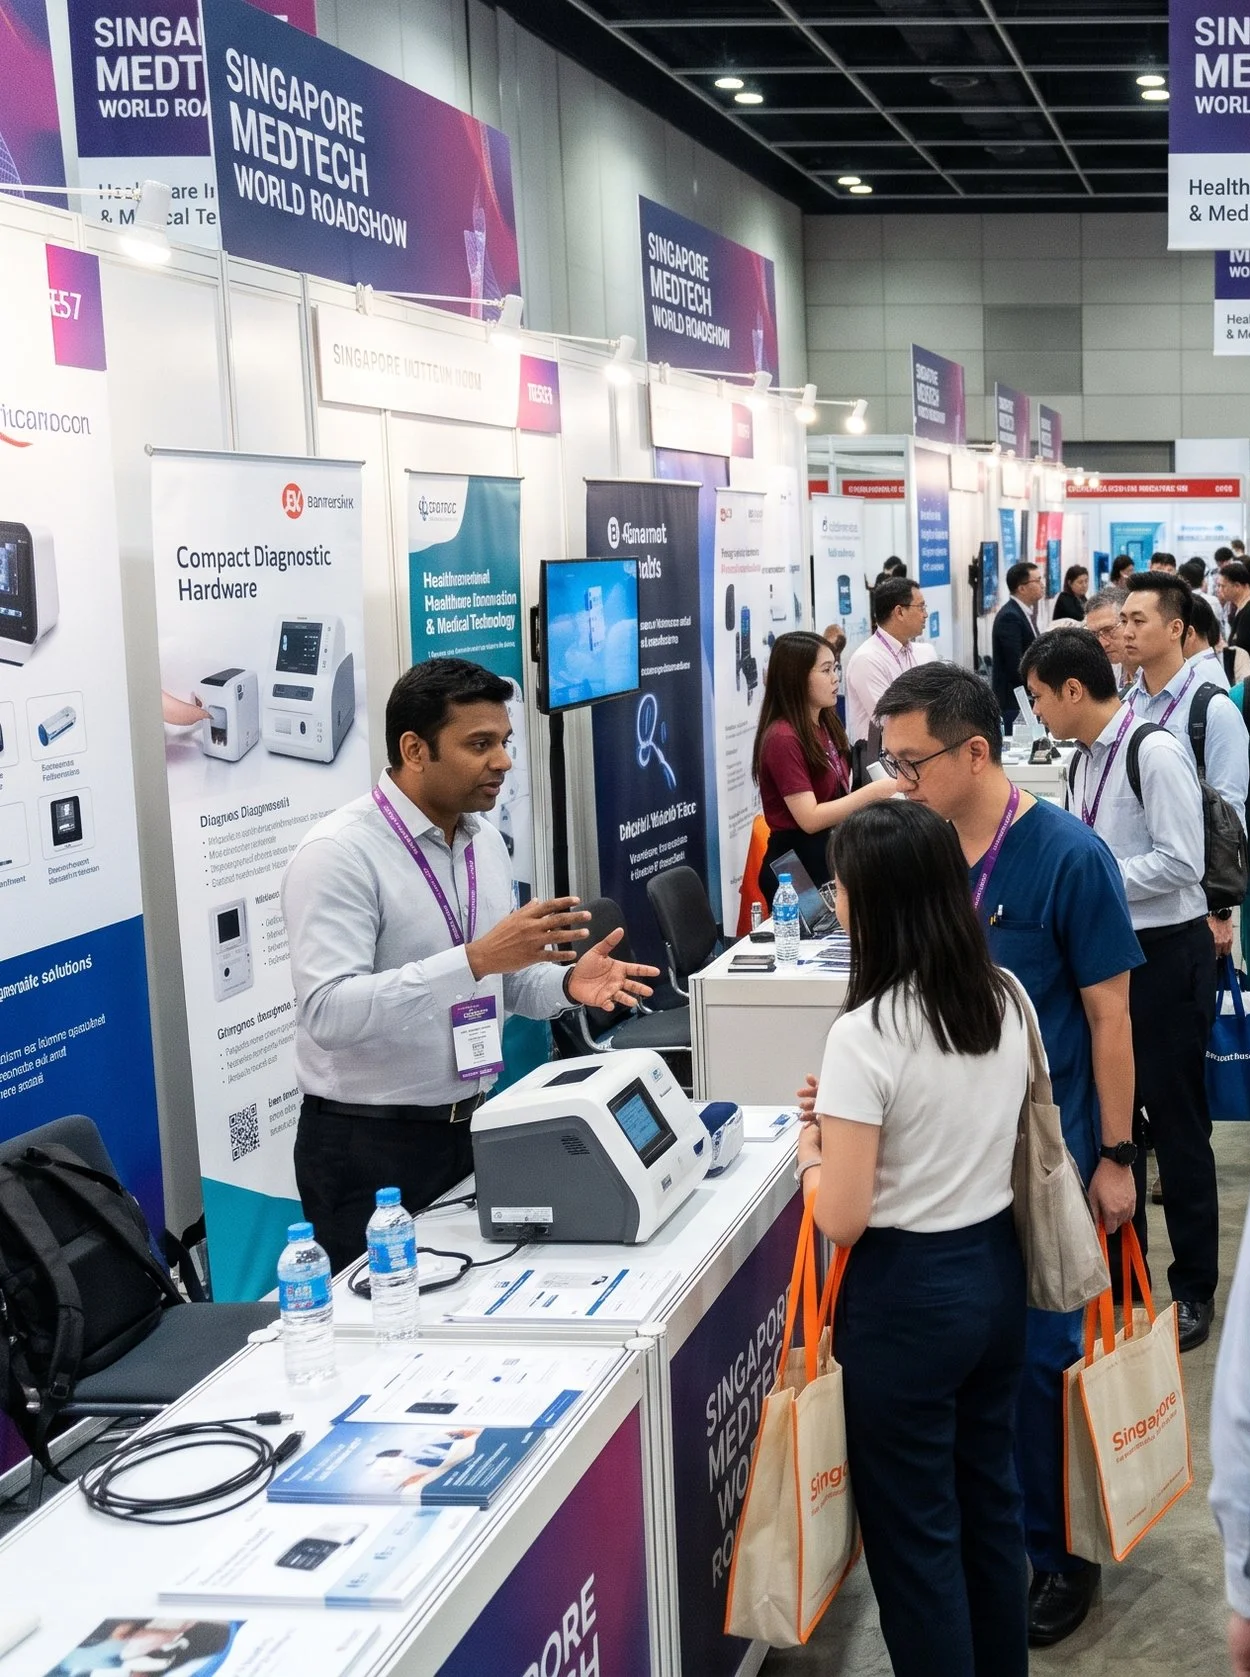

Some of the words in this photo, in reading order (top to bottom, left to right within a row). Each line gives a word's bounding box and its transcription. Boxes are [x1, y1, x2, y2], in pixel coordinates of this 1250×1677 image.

[94, 16, 202, 47] SINGA
[98, 99, 169, 118] WORLD
[225, 48, 365, 144] SINGAPORE
[229, 101, 369, 196] MEDTECH
[233, 162, 305, 217] WORLD
[311, 201, 408, 249] ROADSHOW
[1189, 205, 1202, 222] &
[647, 231, 710, 282] SINGAPORE
[649, 265, 713, 317] MEDTECH
[651, 304, 684, 335] WORLD
[686, 315, 730, 350] ROADSHOW
[1226, 328, 1234, 340] &
[333, 343, 401, 376] SINGAPORE
[176, 545, 251, 575] Compact
[254, 544, 332, 573] Diagnostic
[178, 578, 258, 601] Hardware
[426, 618, 435, 635] &
